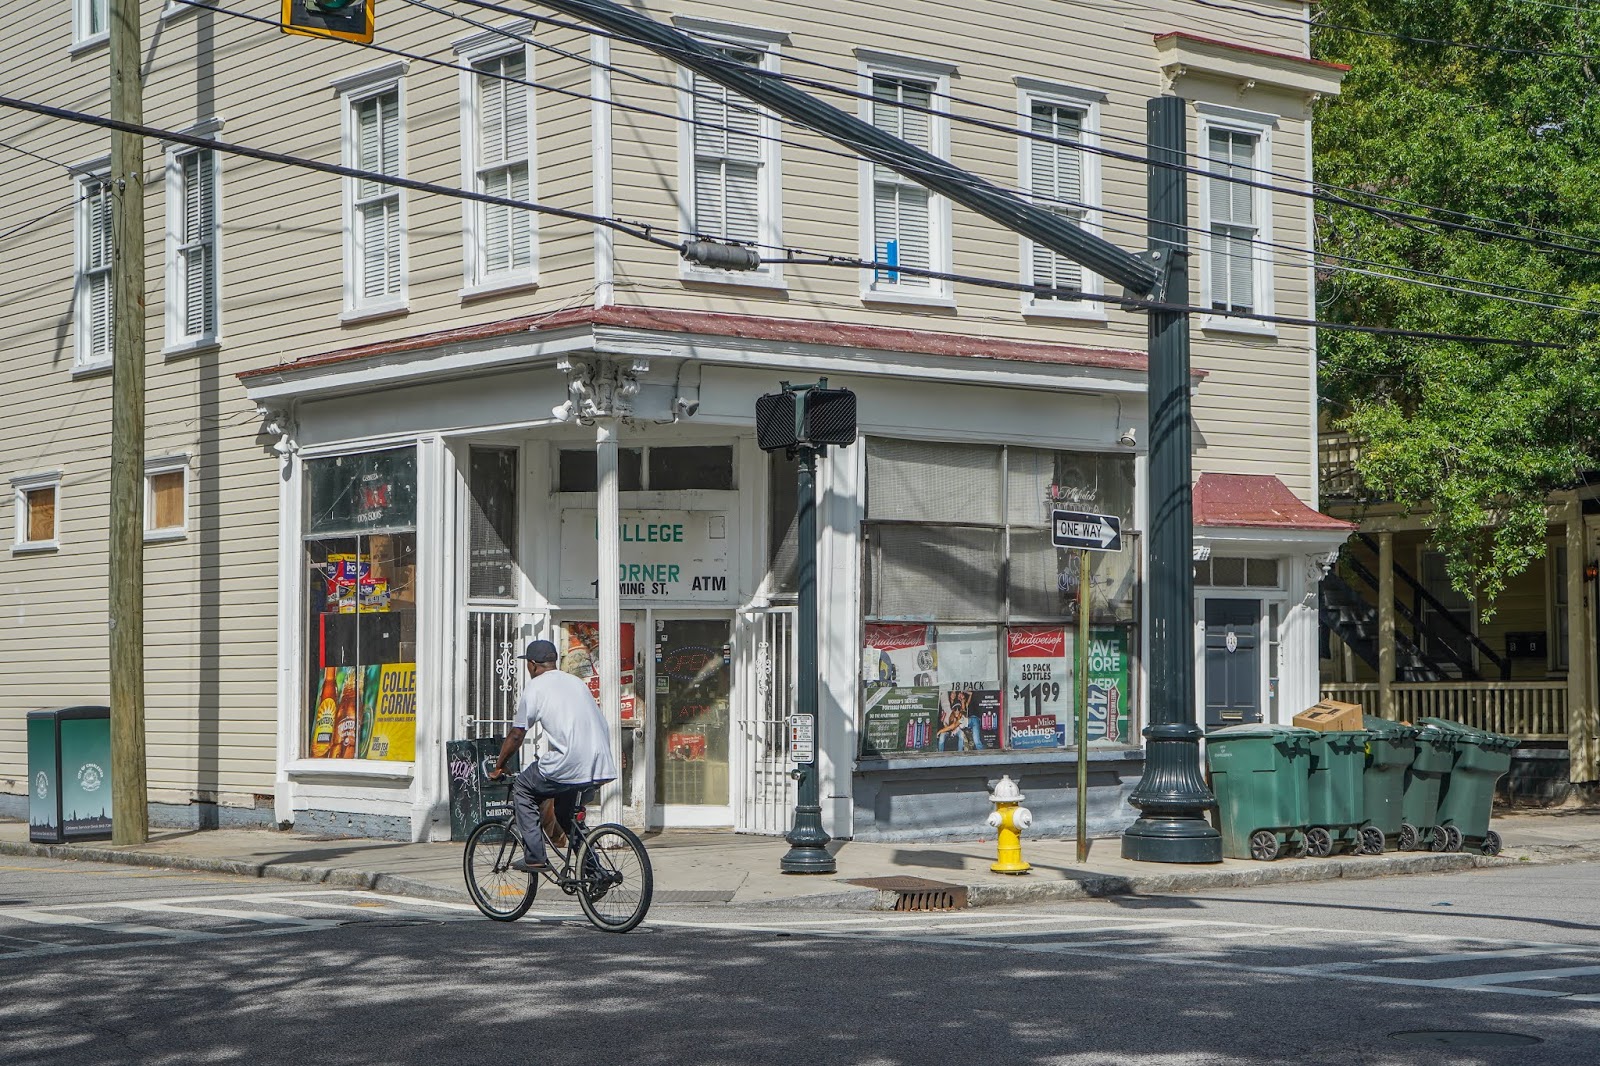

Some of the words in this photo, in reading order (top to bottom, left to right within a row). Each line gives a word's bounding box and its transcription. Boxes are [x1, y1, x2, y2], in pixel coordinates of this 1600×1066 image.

[1060, 521, 1079, 537] ONE
[1082, 523, 1102, 539] WAY
[619, 564, 681, 583] ORNER
[692, 576, 727, 591] ATM
[866, 631, 922, 648] Budweiser
[1009, 631, 1062, 648] Budweiser
[1022, 664, 1031, 672] 12
[1033, 663, 1051, 672] PACK
[382, 671, 416, 693] COLLE
[1022, 672, 1051, 681] BOTTLES
[1088, 678, 1120, 690] VERY
[951, 682, 961, 691] 18
[963, 681, 985, 691] PACK
[678, 705, 713, 721] ATM
[1037, 718, 1055, 727] Mike
[1012, 724, 1056, 739] Seekings
